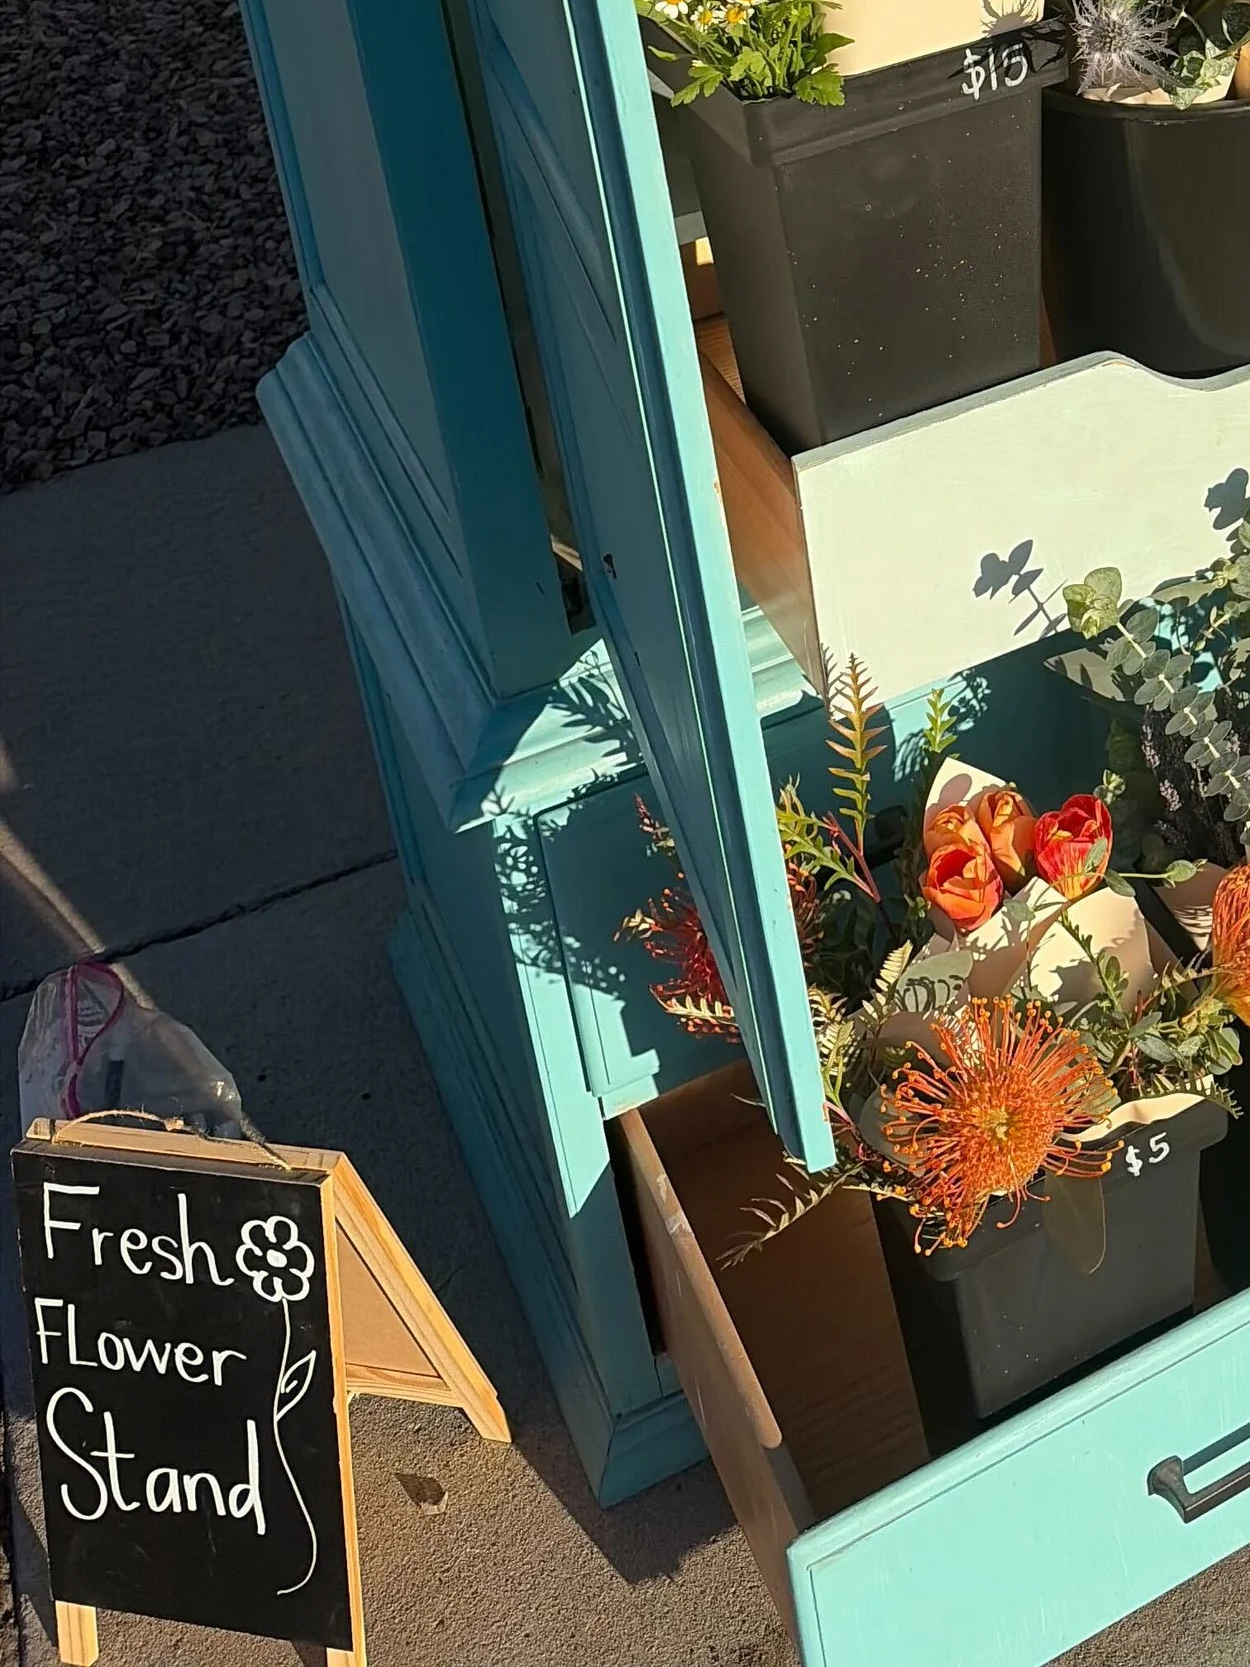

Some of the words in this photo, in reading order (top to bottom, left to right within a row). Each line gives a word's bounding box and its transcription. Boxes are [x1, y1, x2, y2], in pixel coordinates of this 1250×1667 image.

[960, 42, 1029, 100] $15
[1125, 1132, 1170, 1177] $5
[43, 1182, 235, 1285] Fresh
[46, 1386, 266, 1535] Stand
